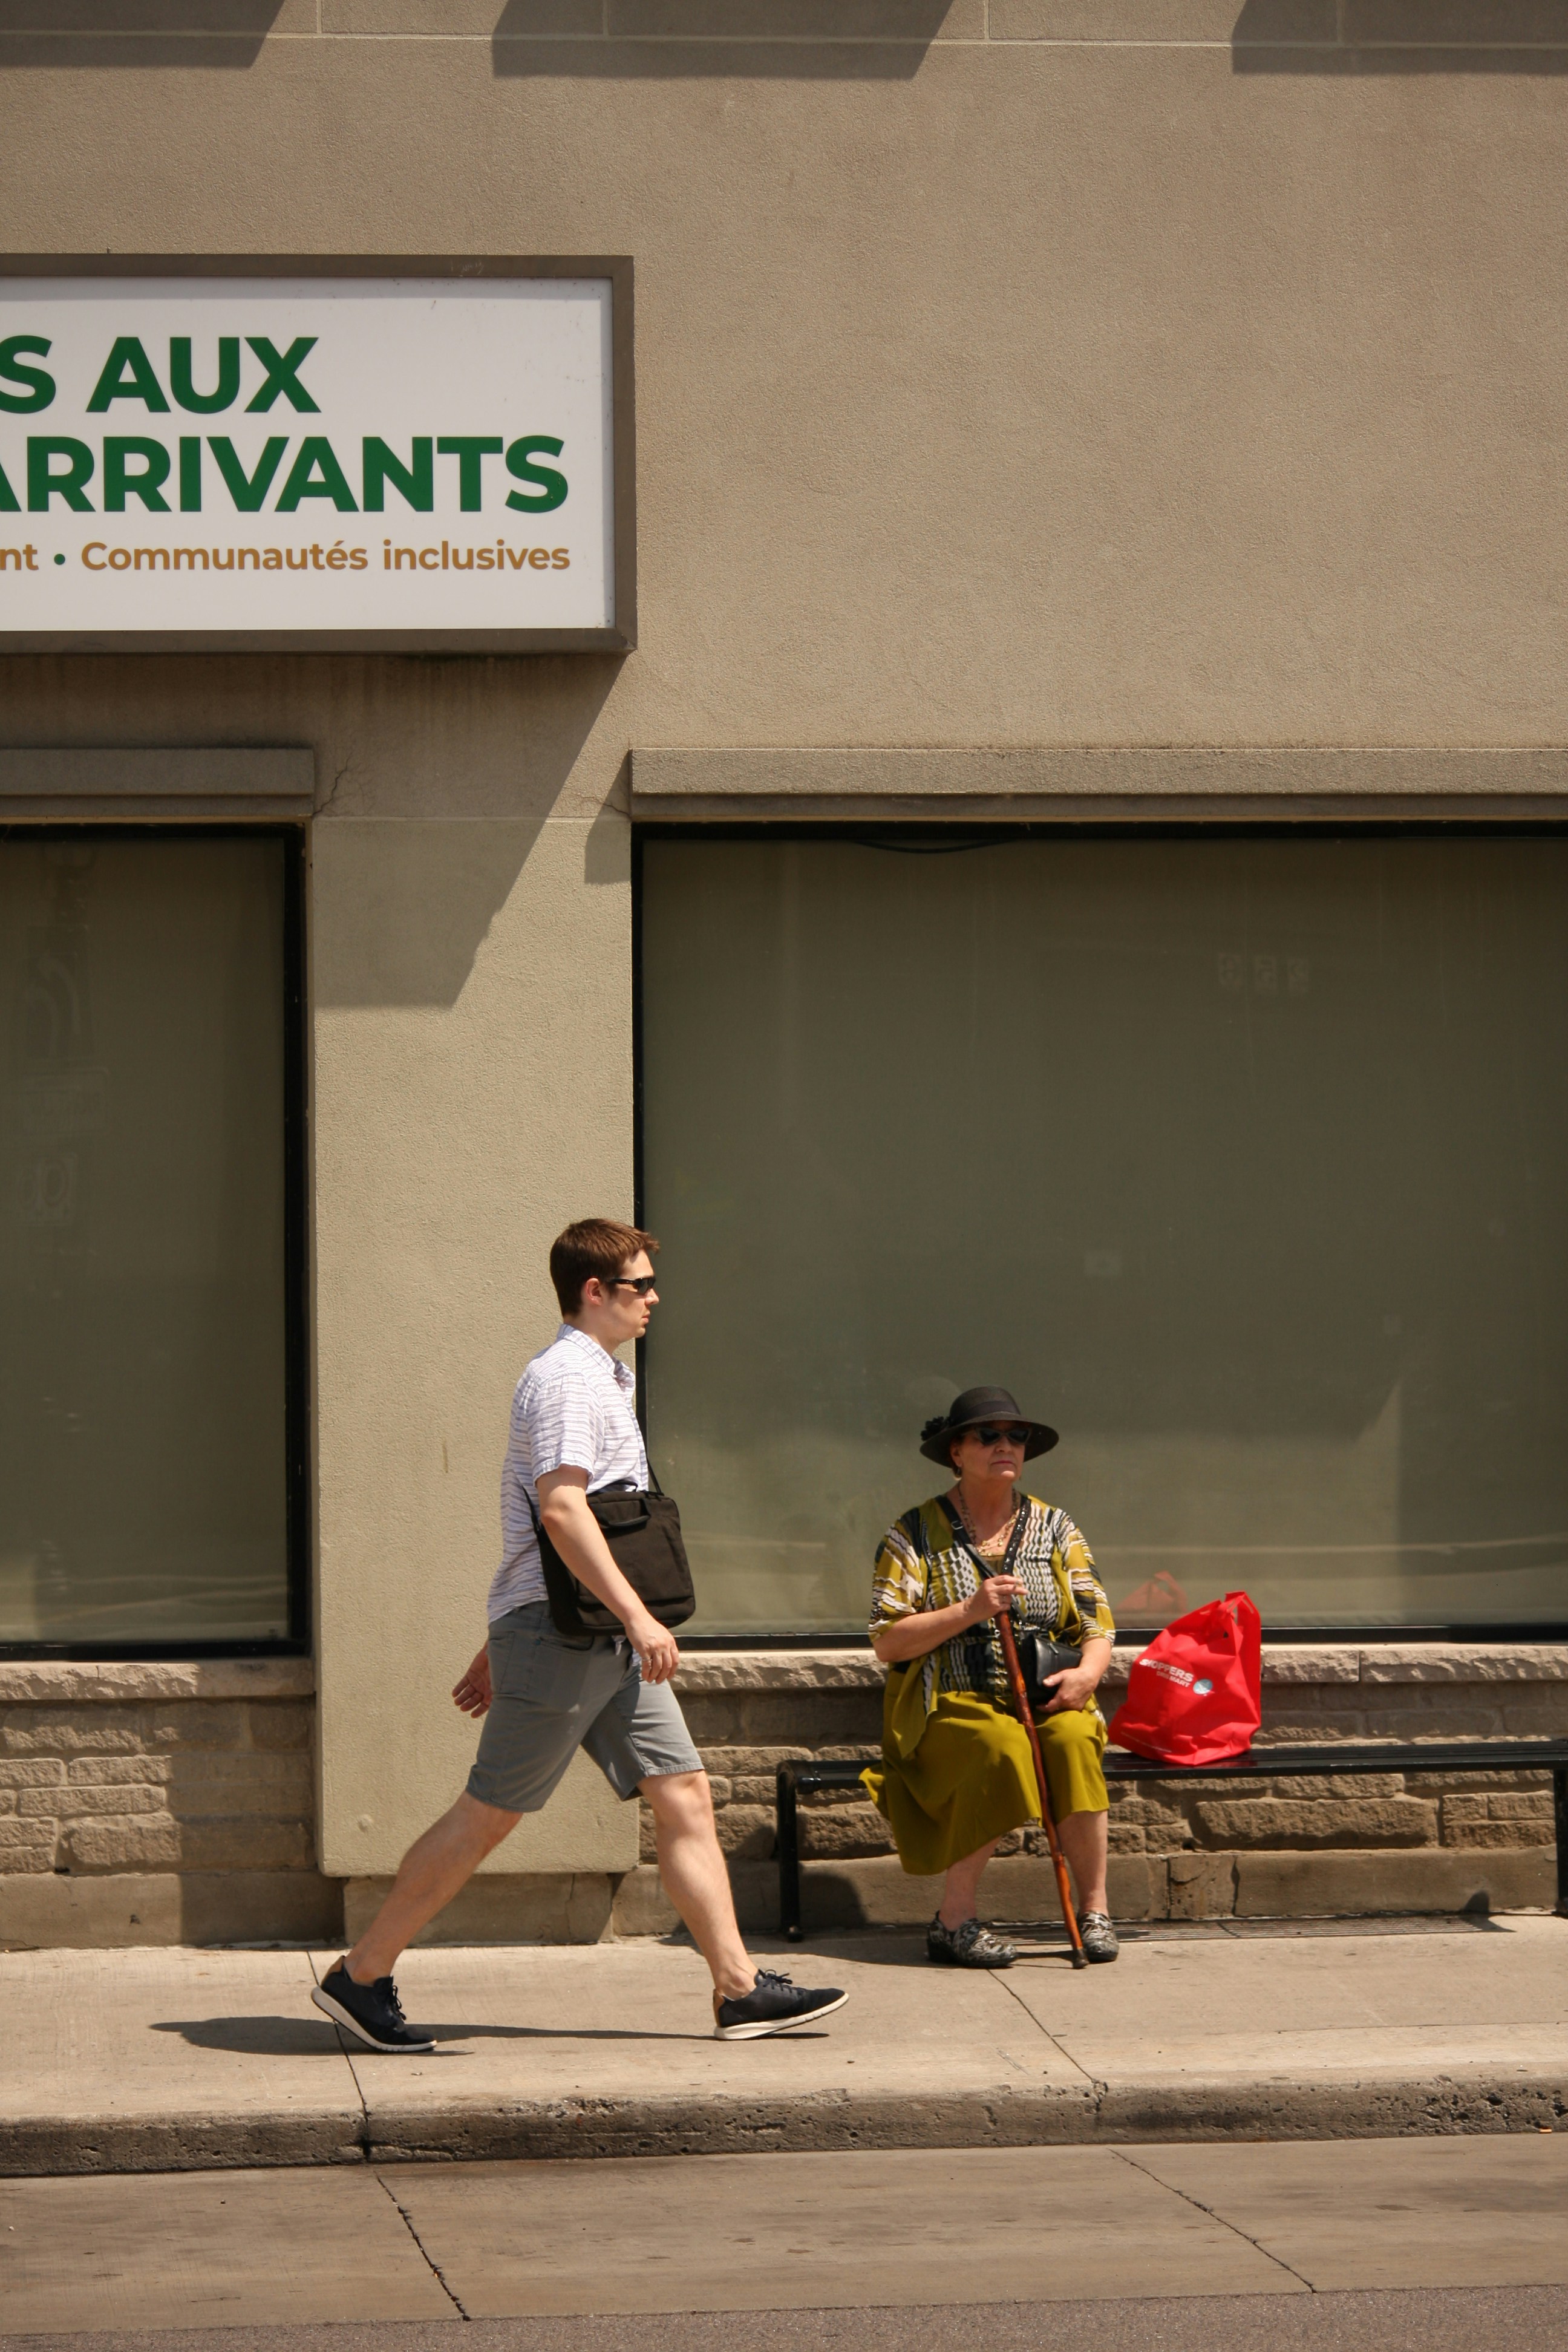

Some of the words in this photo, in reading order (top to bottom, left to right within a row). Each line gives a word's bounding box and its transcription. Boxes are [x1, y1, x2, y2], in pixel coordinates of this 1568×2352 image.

[0, 335, 57, 415] S
[86, 336, 322, 415] AUX
[0, 435, 569, 514] RRIVANTS
[0, 544, 39, 570] nt
[81, 540, 368, 571] Communautés
[383, 538, 570, 570] inclusives
